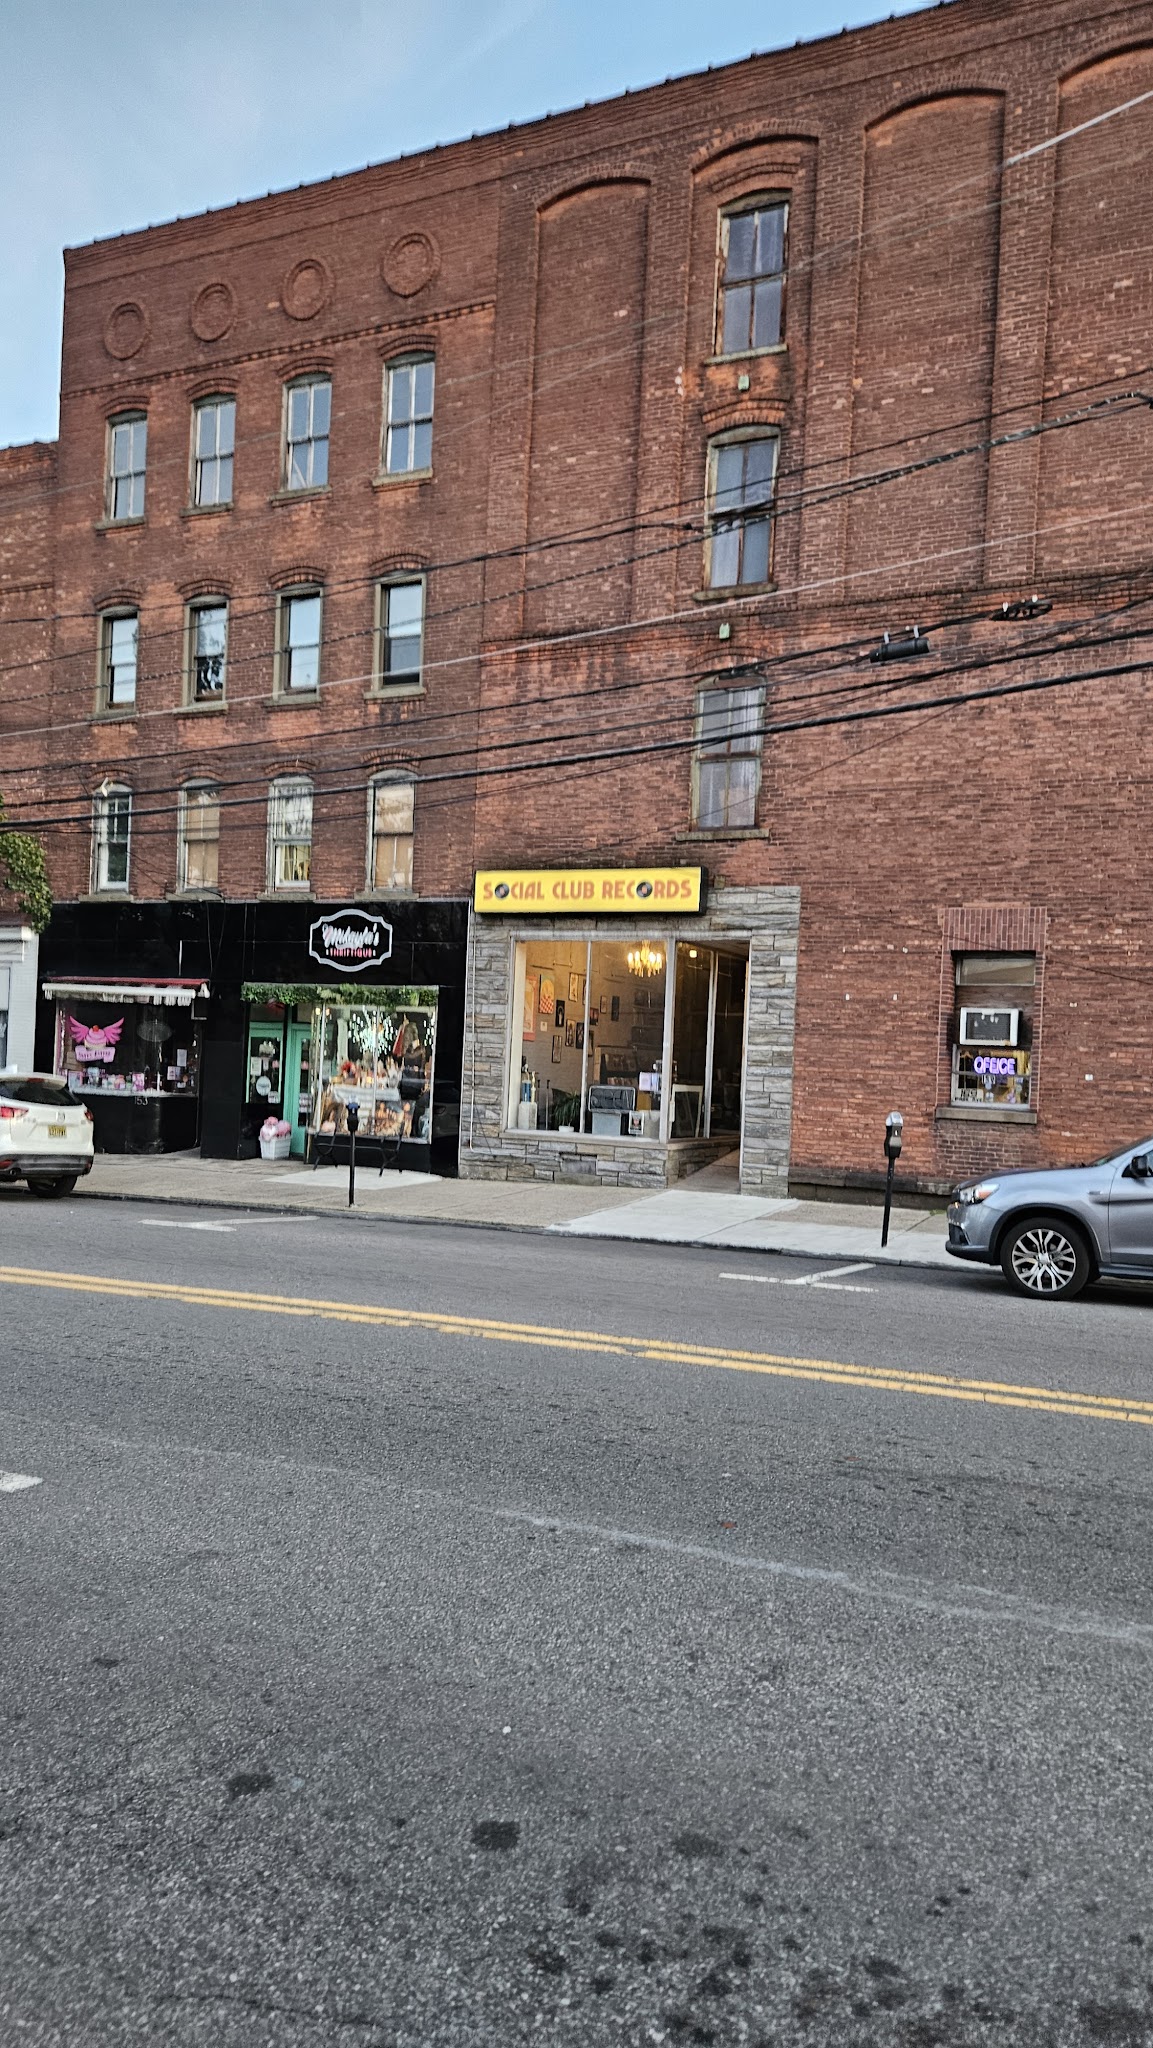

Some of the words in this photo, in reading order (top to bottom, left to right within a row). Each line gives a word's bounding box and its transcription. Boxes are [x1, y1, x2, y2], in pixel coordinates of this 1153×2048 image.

[483, 879, 545, 900] SOCIAL
[552, 879, 595, 900] CLUB
[601, 879, 692, 900] RECORDS
[974, 1056, 1016, 1075] OFFICE
[134, 1096, 149, 1106] 153
